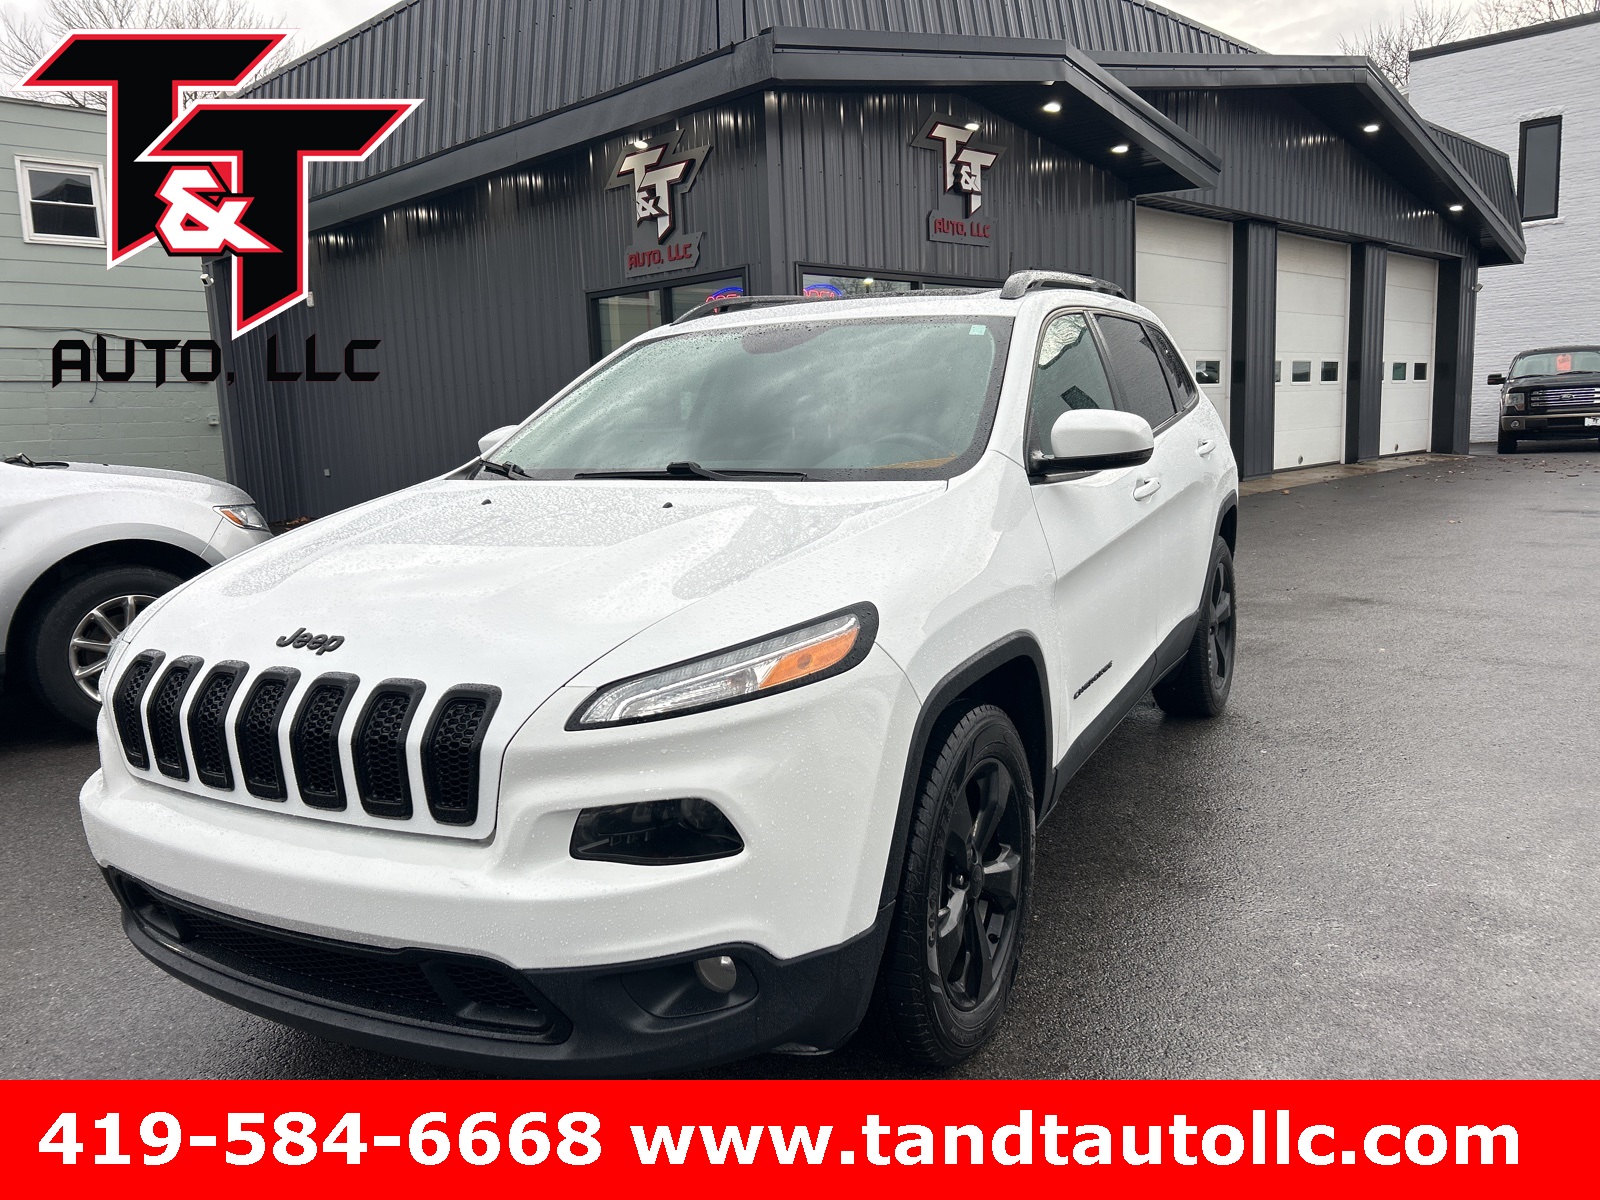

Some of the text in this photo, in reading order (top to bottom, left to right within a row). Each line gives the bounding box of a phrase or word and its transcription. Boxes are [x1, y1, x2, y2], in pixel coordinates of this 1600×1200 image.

[934, 217, 991, 239] AUTO, LLC
[627, 243, 692, 270] AUTO, LLC
[275, 627, 345, 656] Jeep
